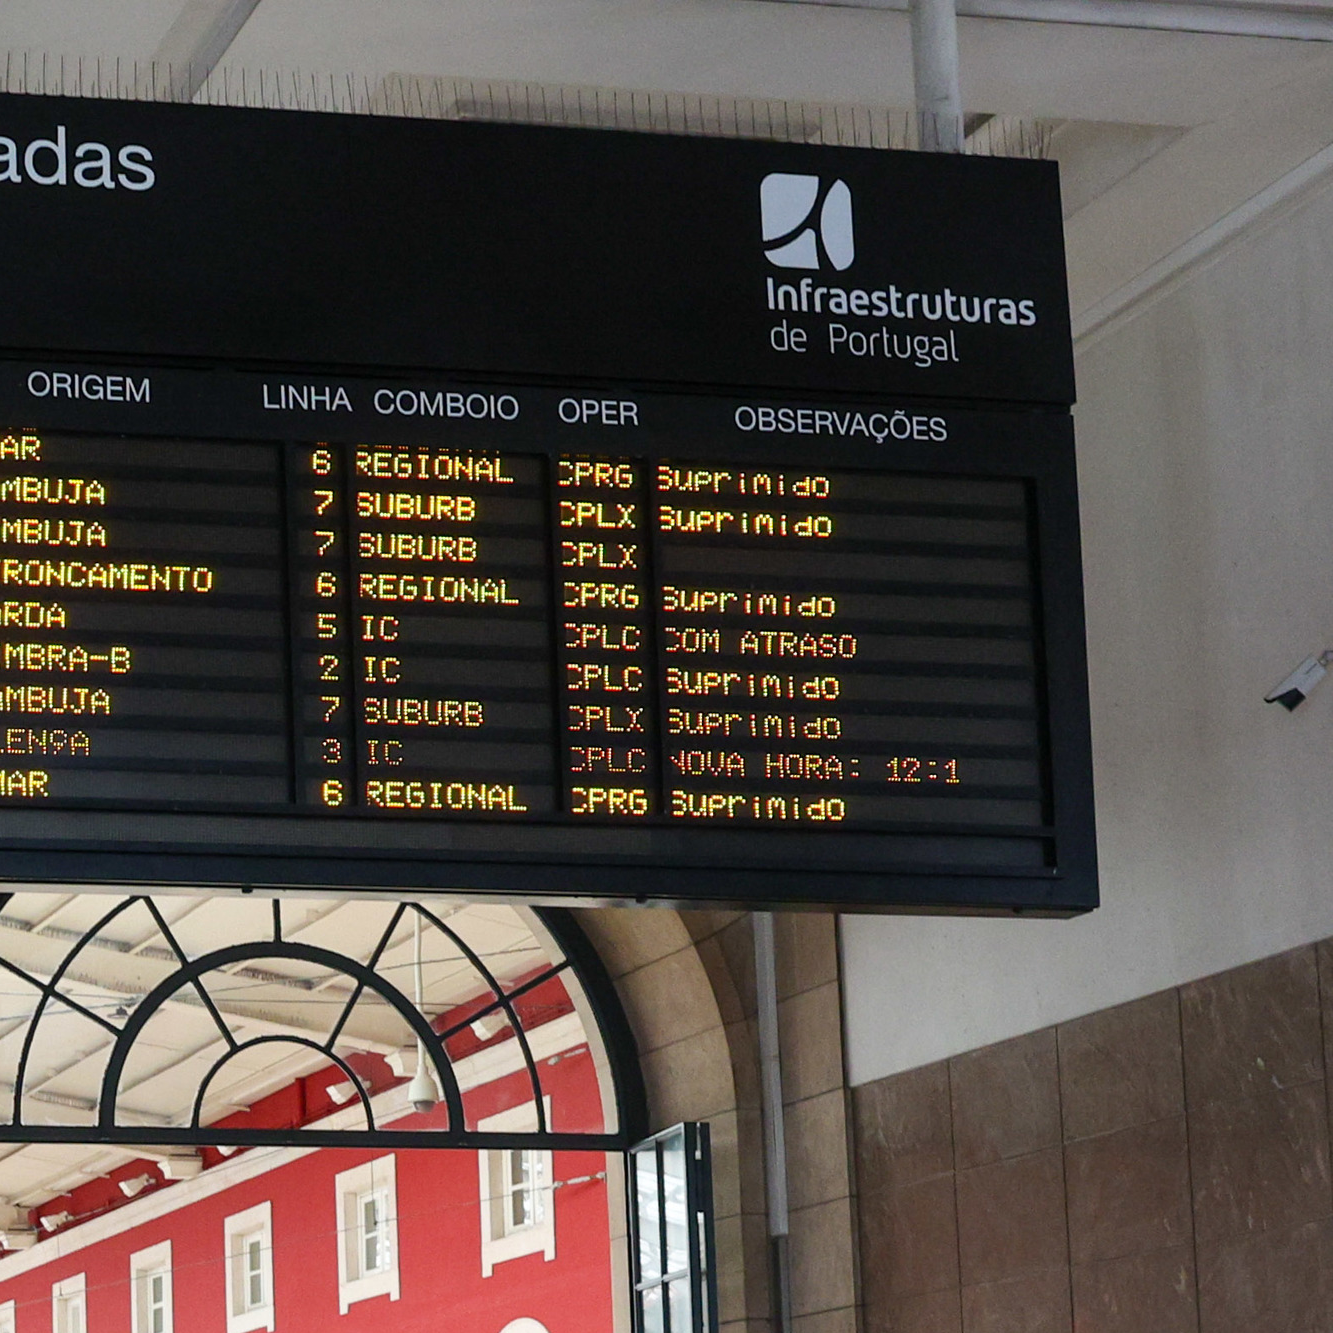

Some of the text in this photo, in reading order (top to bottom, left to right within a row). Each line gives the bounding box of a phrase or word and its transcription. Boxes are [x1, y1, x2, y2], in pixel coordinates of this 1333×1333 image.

[767, 277, 1036, 326] Infraestruturas
[771, 319, 959, 367] de Portugal
[28, 371, 150, 402] ORIGEM
[263, 384, 352, 411] LINHA
[374, 389, 519, 420] COMBOIO
[559, 398, 638, 425] OPER
[735, 406, 947, 443] OBSERVAÇÕES
[357, 452, 513, 483] REGIONAL
[357, 492, 475, 521] SUBURB
[359, 533, 477, 562] SUBURB
[360, 574, 518, 605] REGIONAL
[361, 616, 398, 641] IC
[740, 631, 856, 658] ATRASO
[365, 657, 399, 683] IC
[364, 698, 483, 726] SUBURB
[367, 740, 400, 764] IC
[765, 754, 858, 779] HORA:
[886, 757, 960, 783] 12:1
[367, 781, 525, 811] REGIONAL
